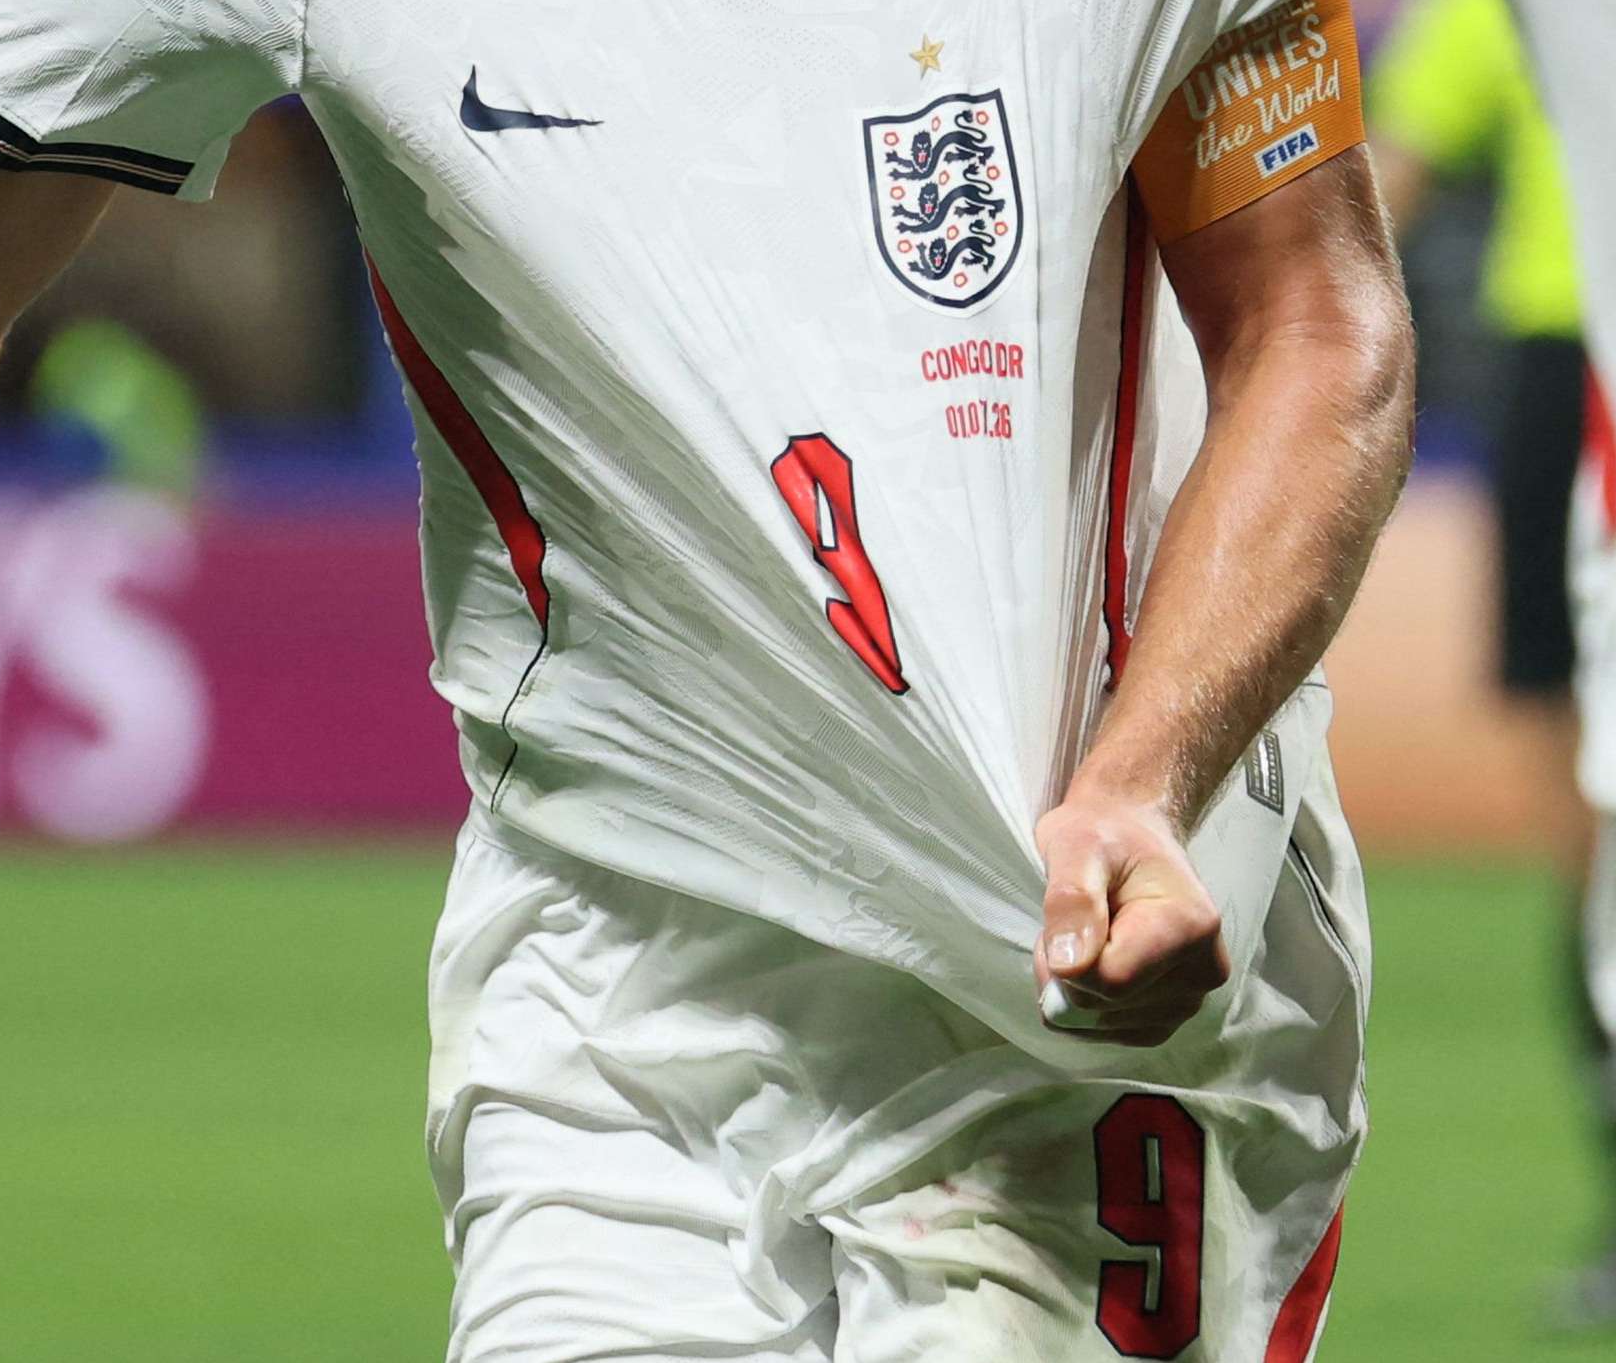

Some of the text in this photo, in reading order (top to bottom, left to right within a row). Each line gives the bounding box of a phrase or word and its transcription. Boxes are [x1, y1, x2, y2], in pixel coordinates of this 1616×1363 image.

[1186, 14, 1328, 121] UNITES
[1197, 58, 1340, 169] the World
[1261, 132, 1315, 172] FIFA
[921, 339, 1024, 383] CONGO DR
[945, 398, 1012, 439] 01.07.26
[770, 432, 911, 695] 9
[1092, 1091, 1206, 1361] 9
